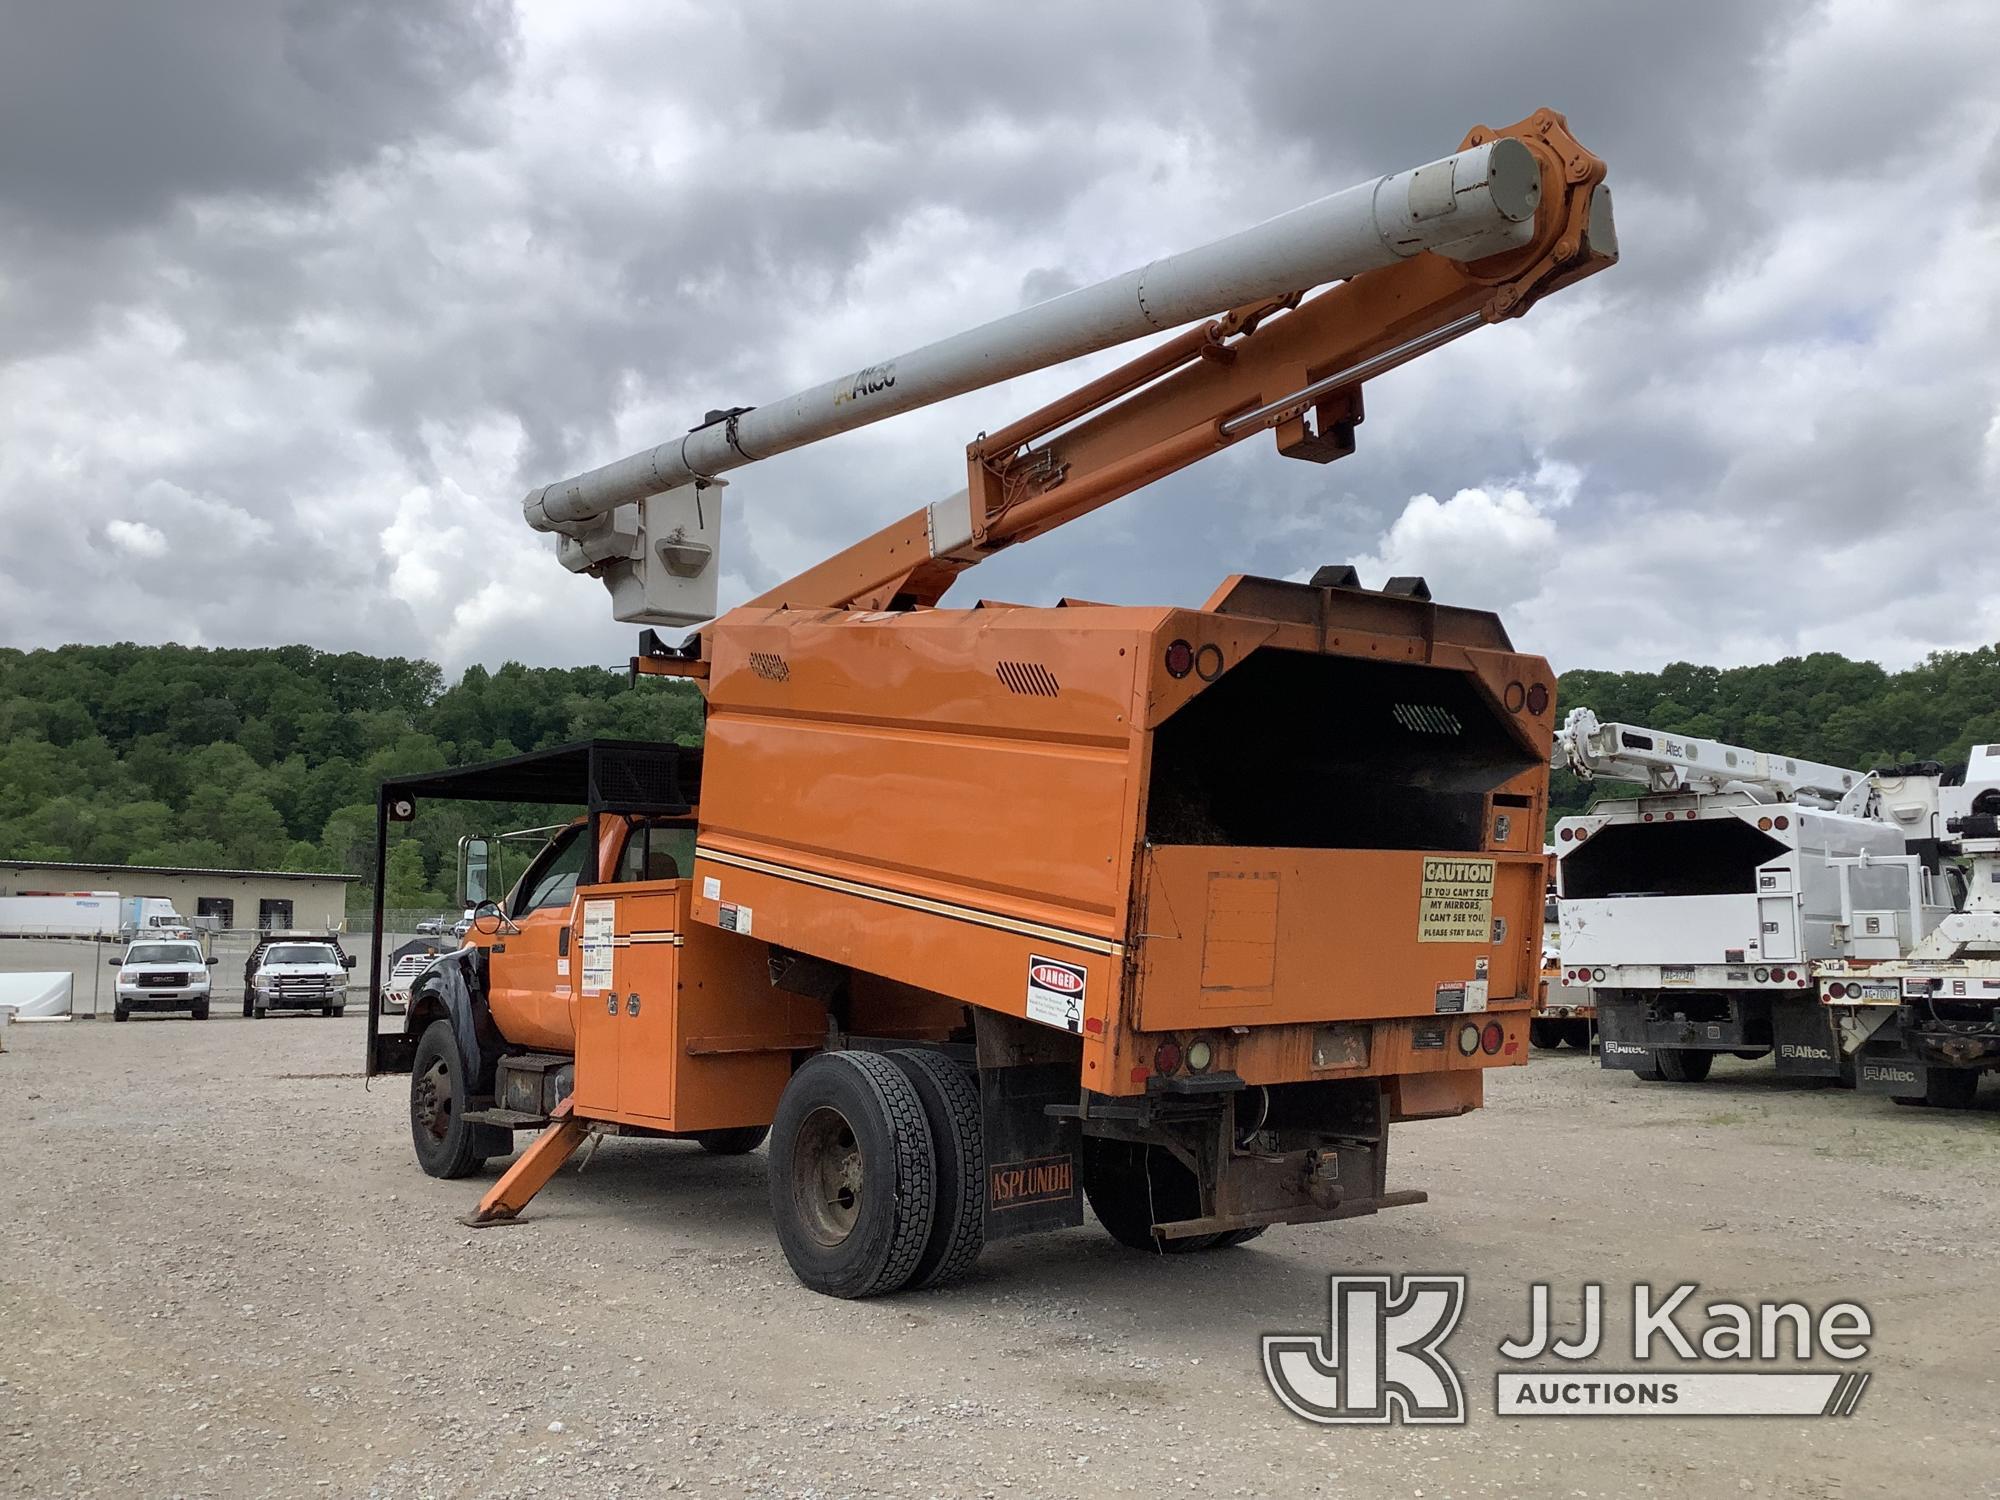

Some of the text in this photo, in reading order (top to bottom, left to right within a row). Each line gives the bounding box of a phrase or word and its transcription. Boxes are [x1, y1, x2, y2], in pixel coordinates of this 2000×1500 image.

[1666, 740, 1682, 758] Altec
[1426, 863, 1492, 882] CAUTION
[1425, 888, 1432, 896] IF
[1434, 888, 1451, 897] YOU
[1476, 889, 1489, 897] SEE
[1430, 901, 1482, 911] MY MIRRORS,
[1453, 914, 1466, 922] SEE
[1424, 929, 1448, 937] PLEASE
[1449, 929, 1465, 937] STAY
[1039, 967, 1075, 990] DANGER
[1795, 1045, 1828, 1058] Altec
[1880, 1067, 1914, 1082] Altec
[993, 1163, 1070, 1201] ASPLUNDH
